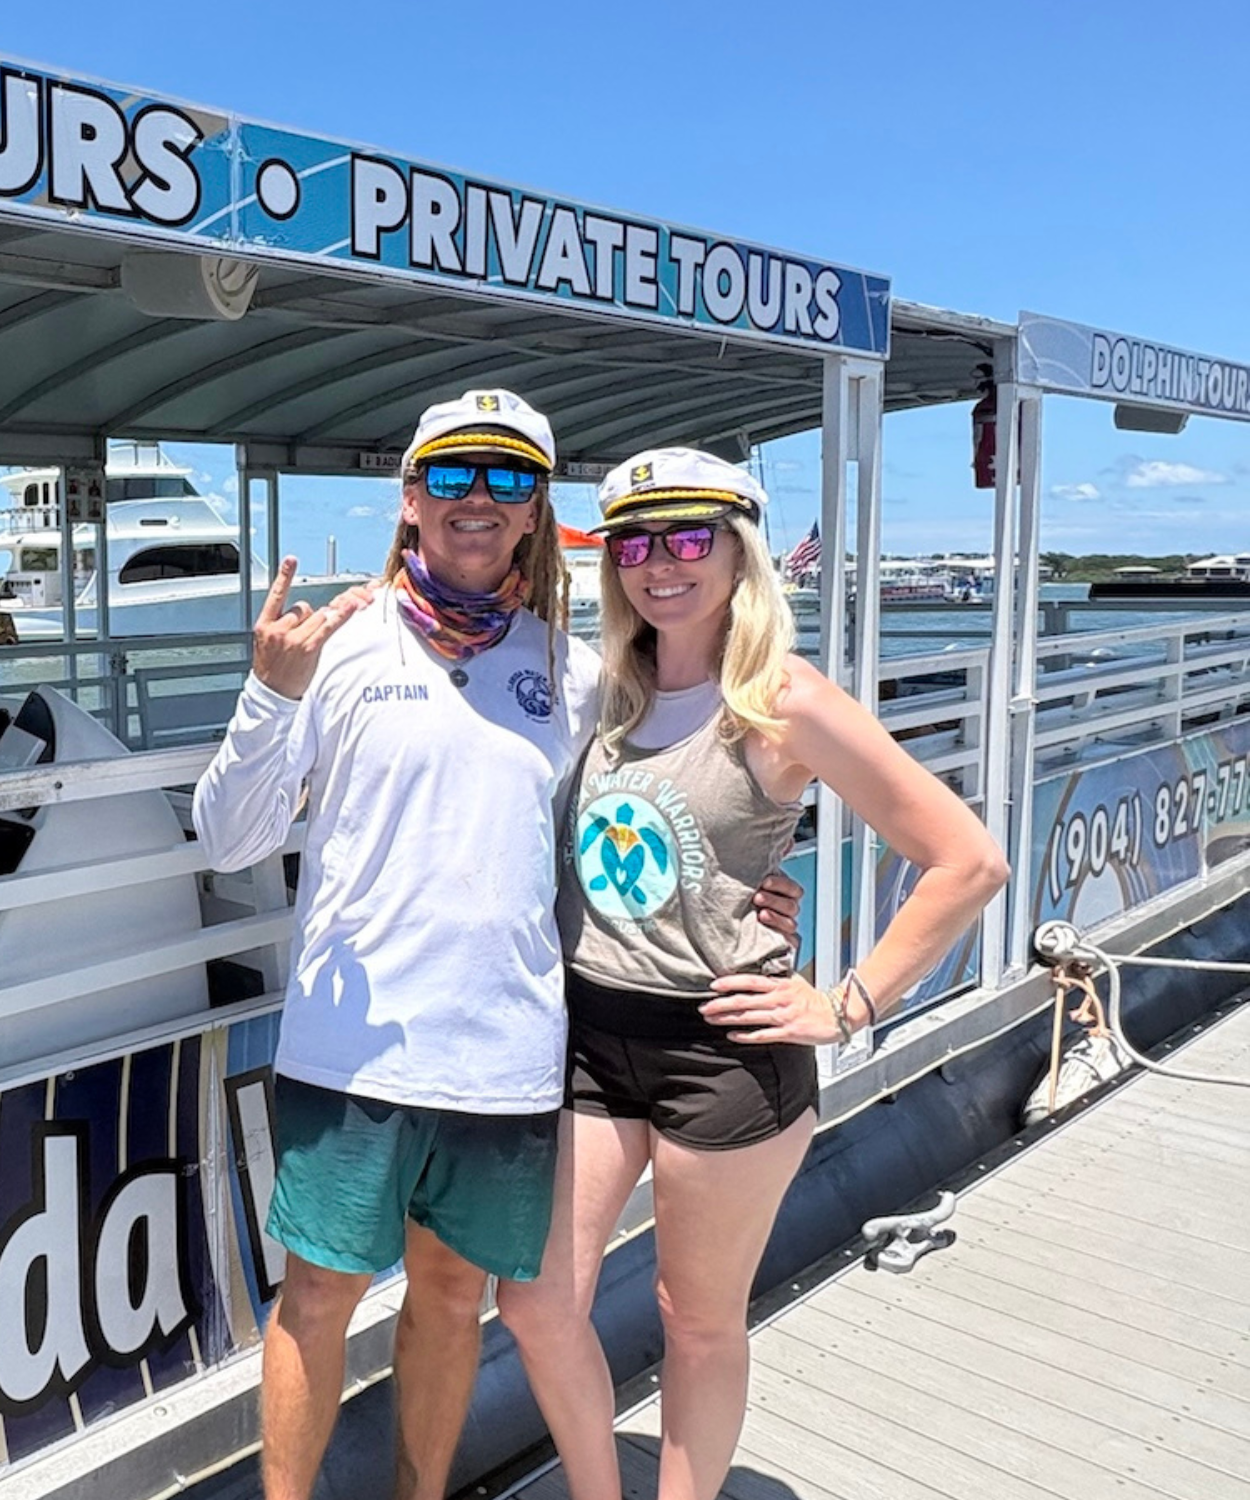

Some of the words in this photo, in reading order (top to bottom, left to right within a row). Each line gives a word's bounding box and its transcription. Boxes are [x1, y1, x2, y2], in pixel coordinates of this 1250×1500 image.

[350, 152, 658, 311] PRIVATE
[669, 233, 843, 341] TOURS
[1091, 333, 1194, 402] DOLPHIN
[1196, 357, 1250, 414] TOUR
[362, 684, 429, 703] CAPTAIN
[588, 769, 656, 796] WATER
[654, 778, 706, 894] WARRIORS
[1048, 789, 1142, 909] (904)
[1153, 754, 1250, 850] 827-77
